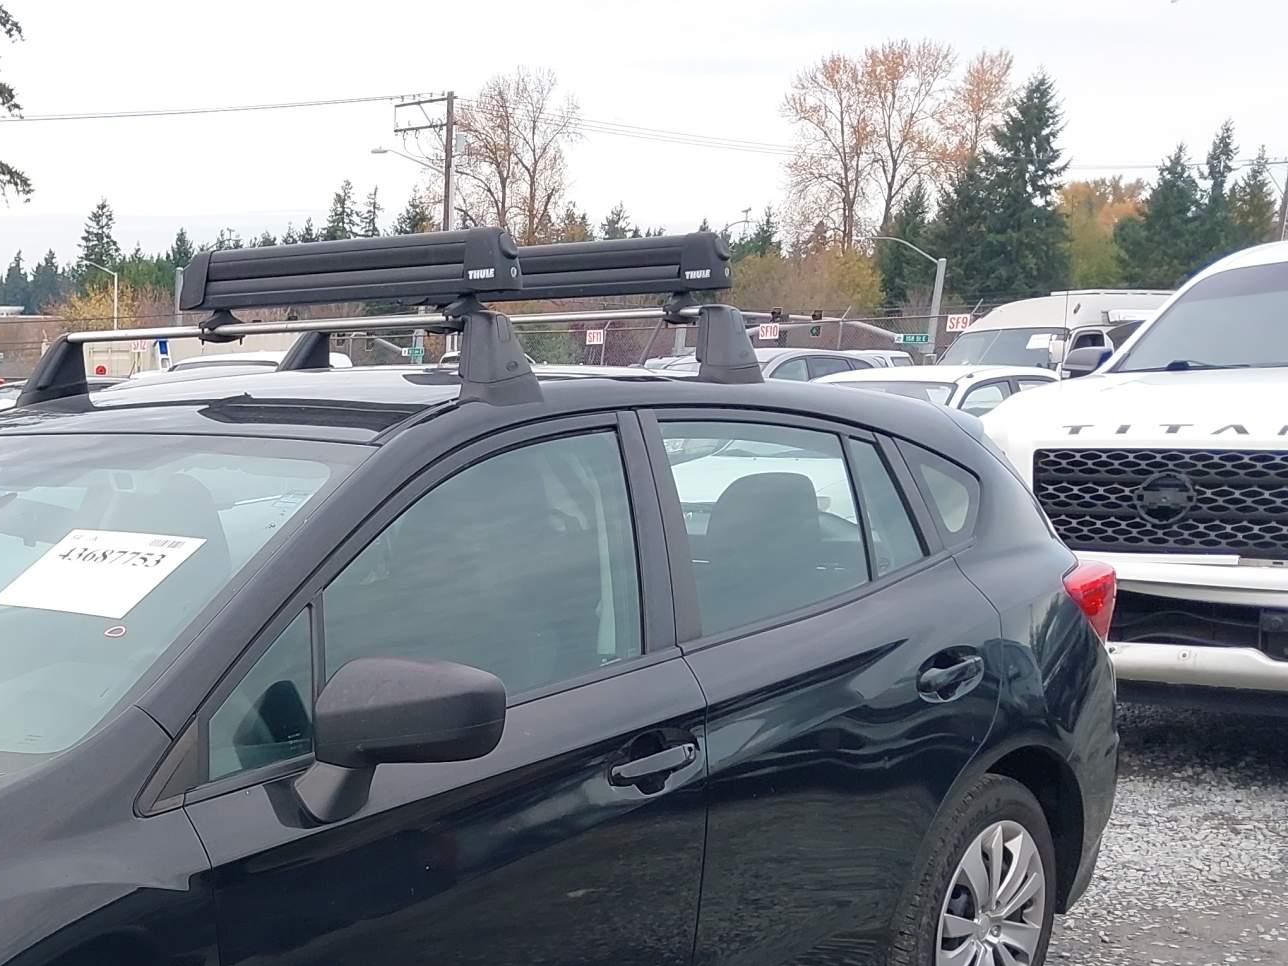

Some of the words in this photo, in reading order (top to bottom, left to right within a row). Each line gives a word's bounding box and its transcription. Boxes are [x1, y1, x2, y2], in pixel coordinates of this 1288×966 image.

[468, 268, 495, 280] THULE
[685, 269, 711, 280] THULE
[948, 316, 968, 329] SF9
[587, 331, 602, 343] SF11
[760, 324, 778, 338] SF10
[58, 547, 167, 568] 43687753
